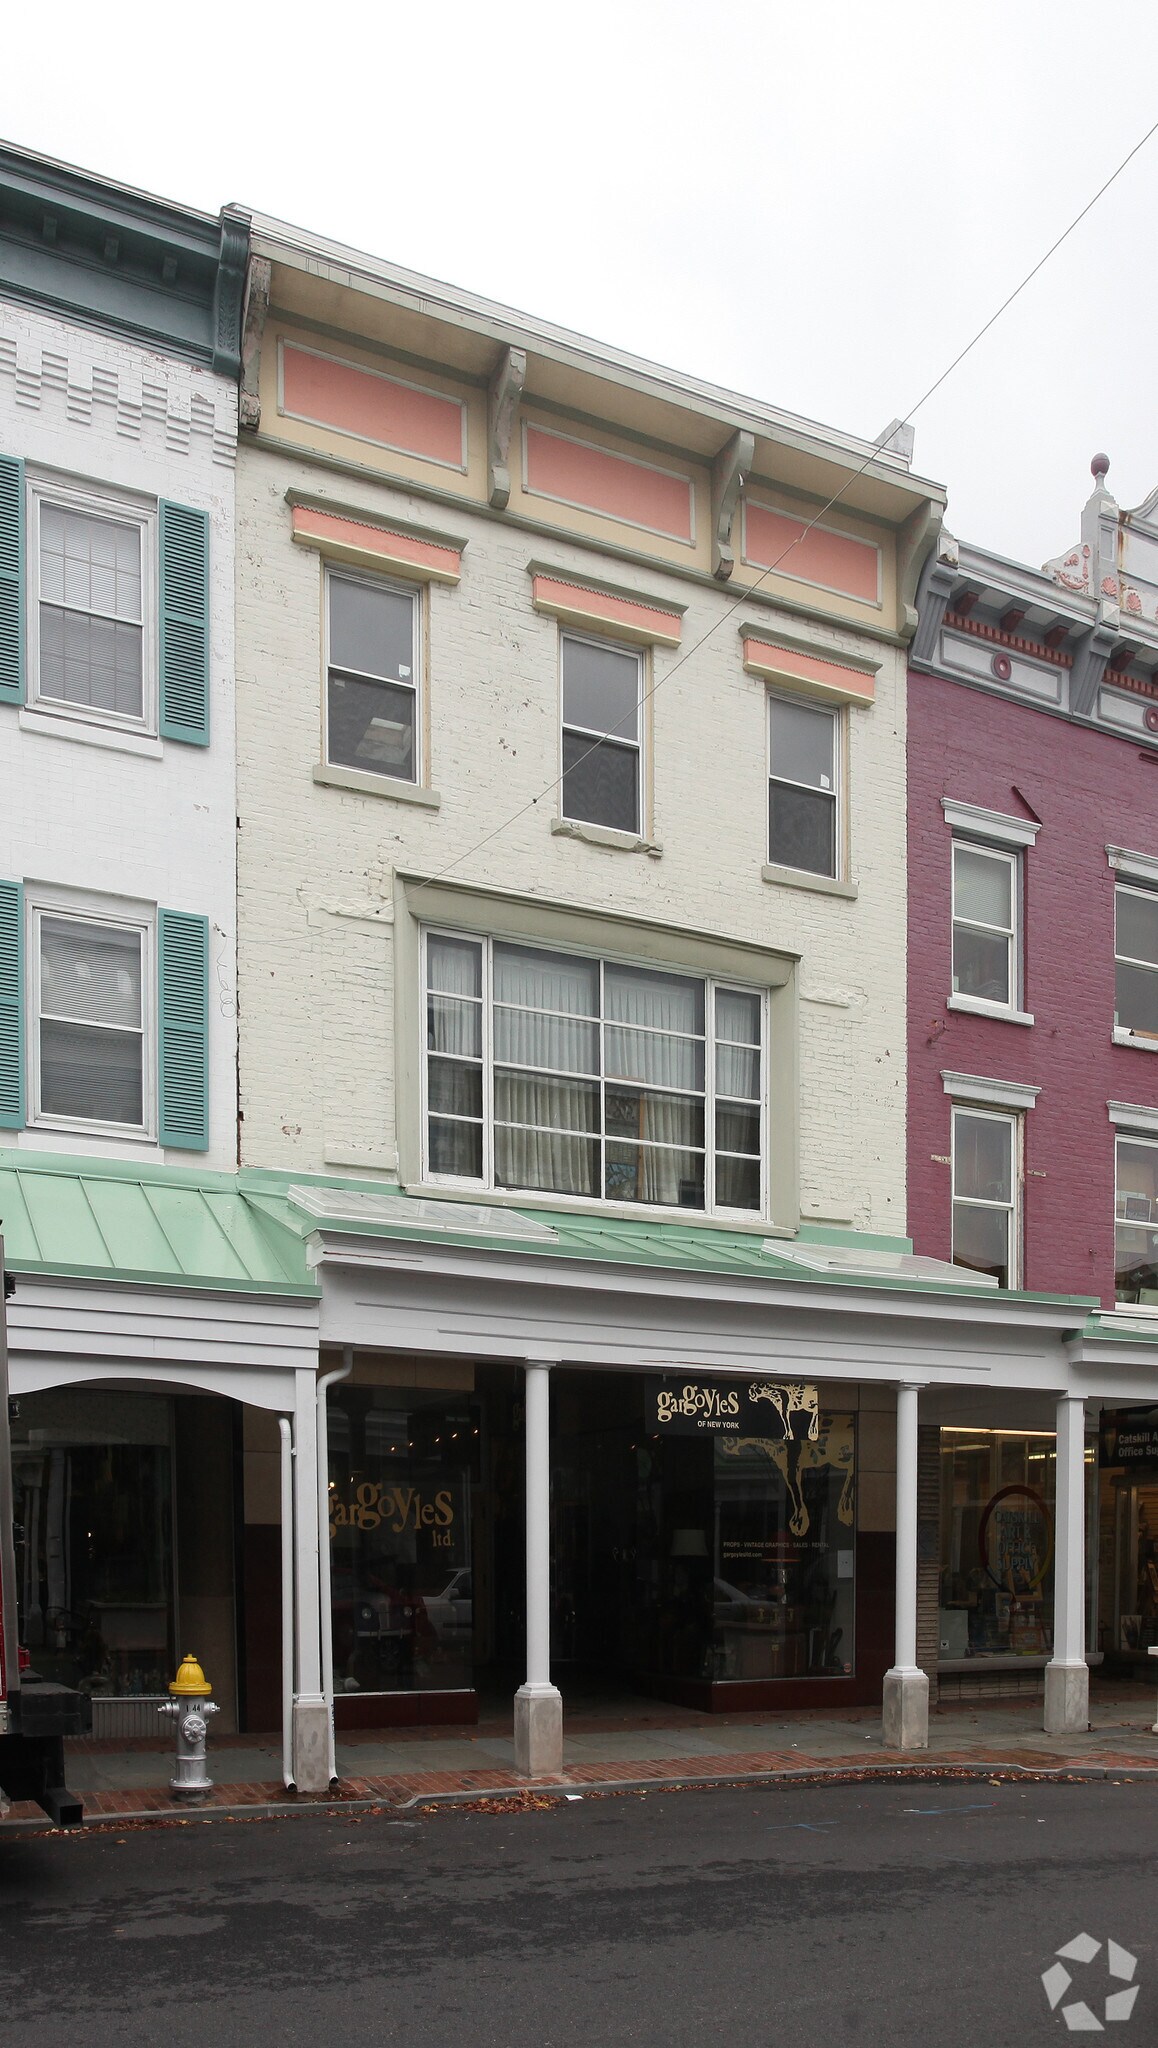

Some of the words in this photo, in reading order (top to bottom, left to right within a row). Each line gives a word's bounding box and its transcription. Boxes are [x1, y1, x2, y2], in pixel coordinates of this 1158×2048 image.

[657, 1385, 739, 1422] gargoyles
[697, 1420, 707, 1428] OF
[722, 1421, 740, 1429] YORK
[1118, 1432, 1150, 1445] Catskill
[1118, 1447, 1143, 1458] Office
